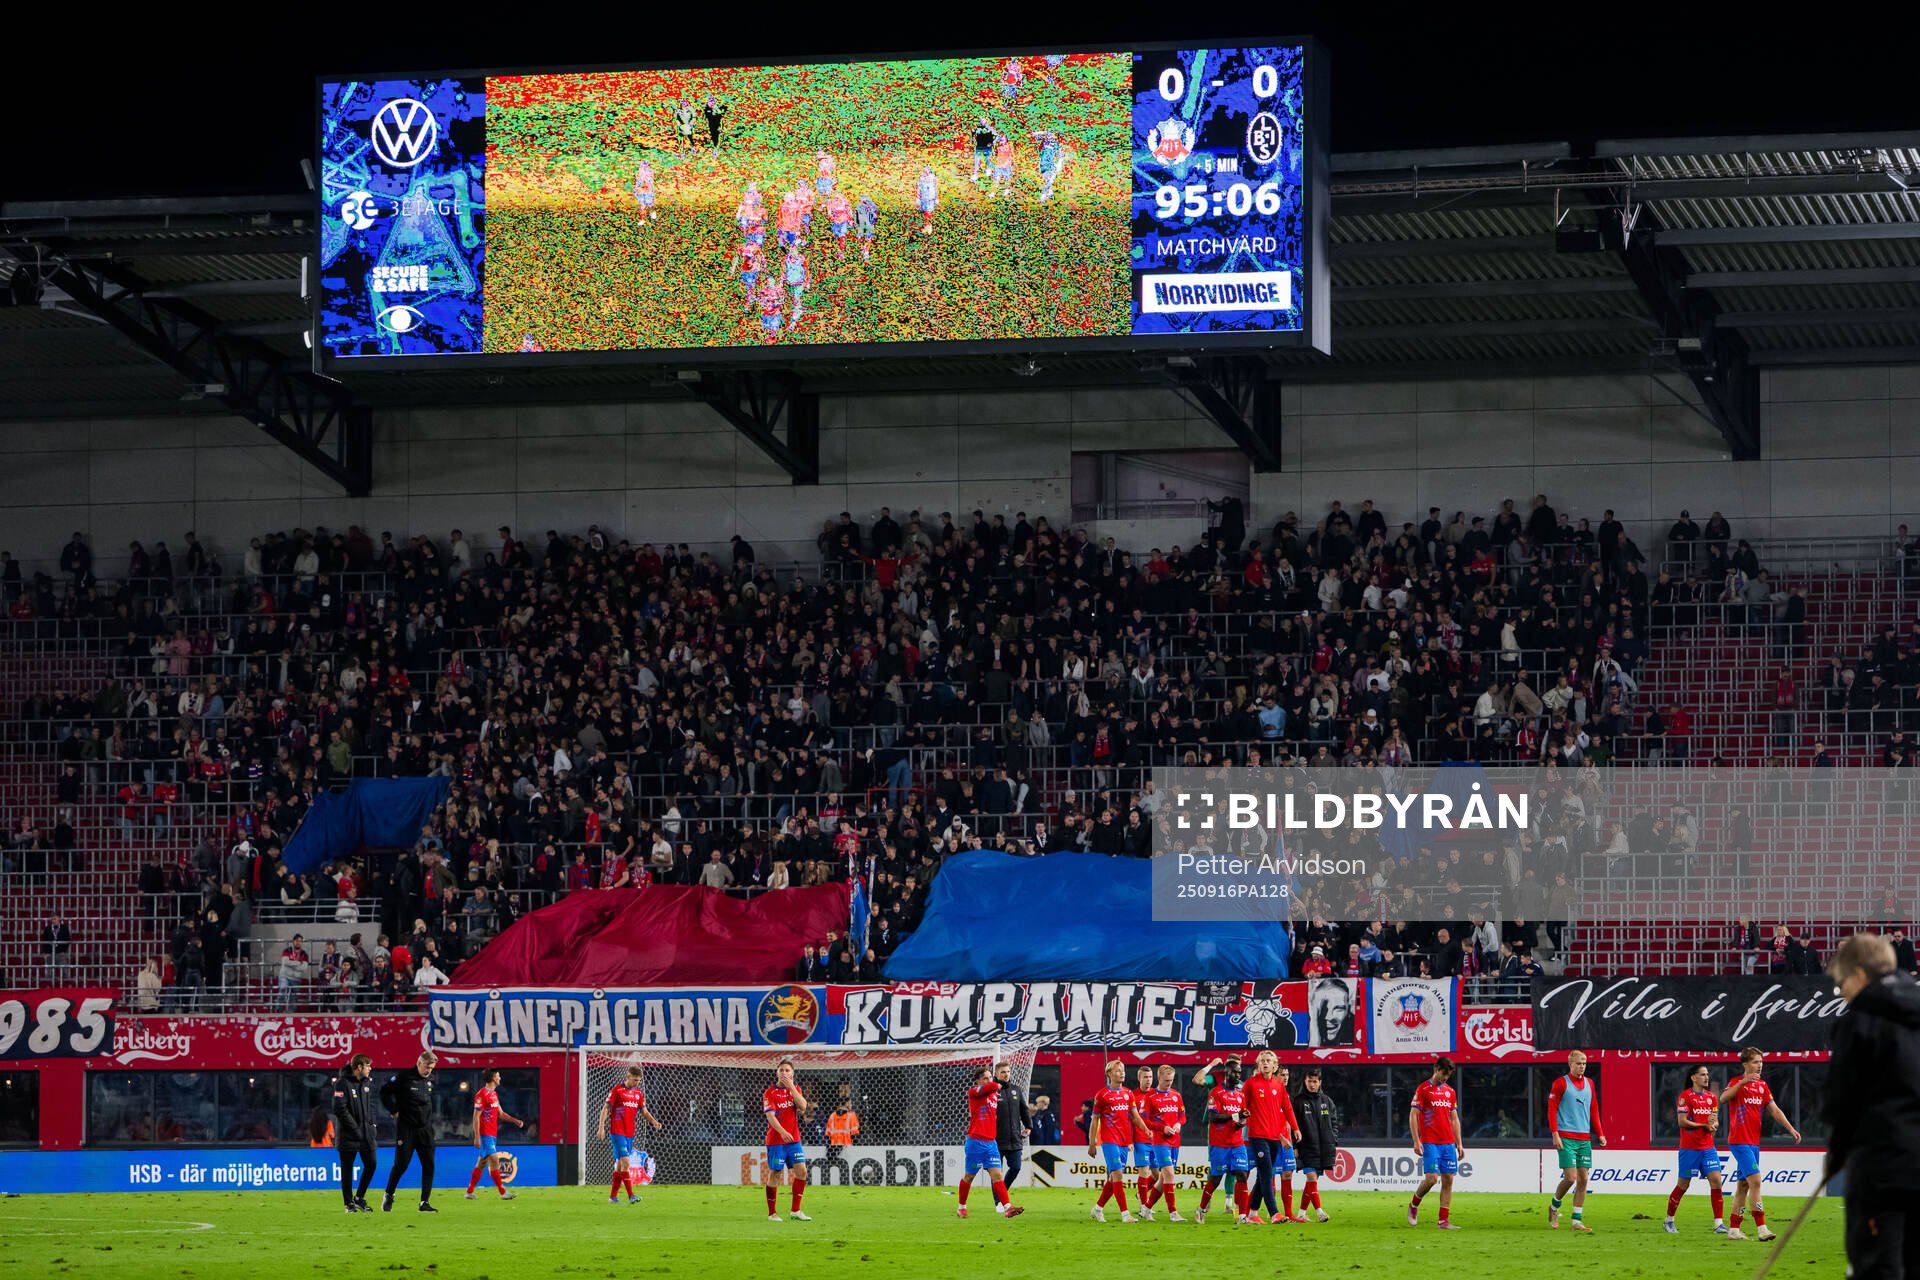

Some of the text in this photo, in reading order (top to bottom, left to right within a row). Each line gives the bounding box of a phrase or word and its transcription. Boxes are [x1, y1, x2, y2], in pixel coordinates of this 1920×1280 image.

[1158, 67, 1185, 101] 0
[1252, 64, 1278, 98] 0
[1217, 158, 1238, 172] MIN
[1155, 183, 1281, 218] 95:06
[1157, 235, 1277, 256] MATCHVÄRD
[372, 265, 428, 278] SECURE
[373, 277, 428, 292] &SAFE
[1154, 281, 1280, 306] NORRVIDINGE
[895, 981, 955, 995] ACAB
[1540, 977, 1682, 1029] Vila
[1701, 993, 1728, 1020] i
[431, 988, 752, 1045] SKÅNEPÅGARNA
[255, 1020, 353, 1057] Carlsberg
[920, 1027, 1141, 1047] Helsingborg
[1465, 1013, 1533, 1050] Carlsb
[130, 1164, 162, 1184] HSB
[180, 1164, 208, 1183] där
[212, 1163, 327, 1187] möjligheterna
[332, 1162, 361, 1182] br
[1359, 1157, 1473, 1177] AllOfe
[1373, 1177, 1398, 1185] lokala
